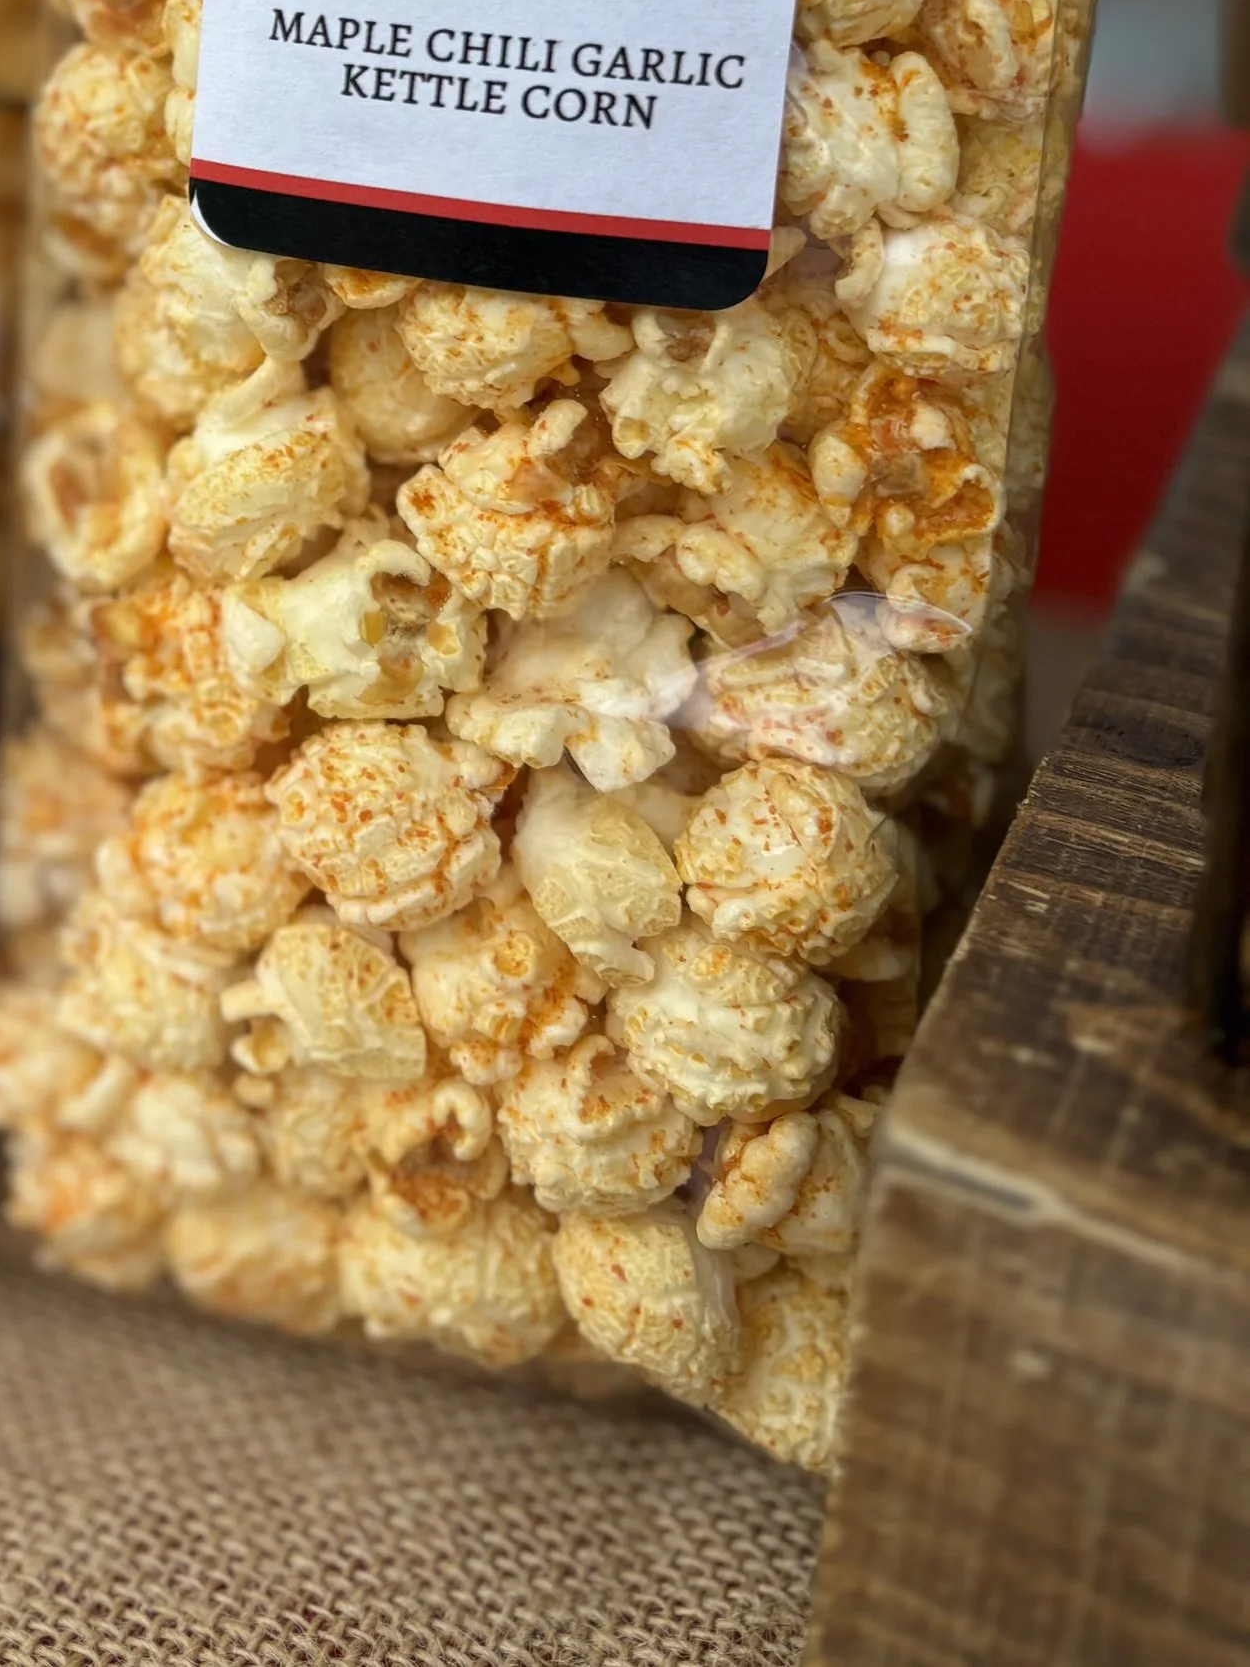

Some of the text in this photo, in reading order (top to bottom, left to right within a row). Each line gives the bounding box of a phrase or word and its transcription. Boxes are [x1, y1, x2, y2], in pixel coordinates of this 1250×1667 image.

[269, 8, 746, 90] MAPLE CHILI GARLIC
[340, 63, 658, 130] KETTLE CORN
